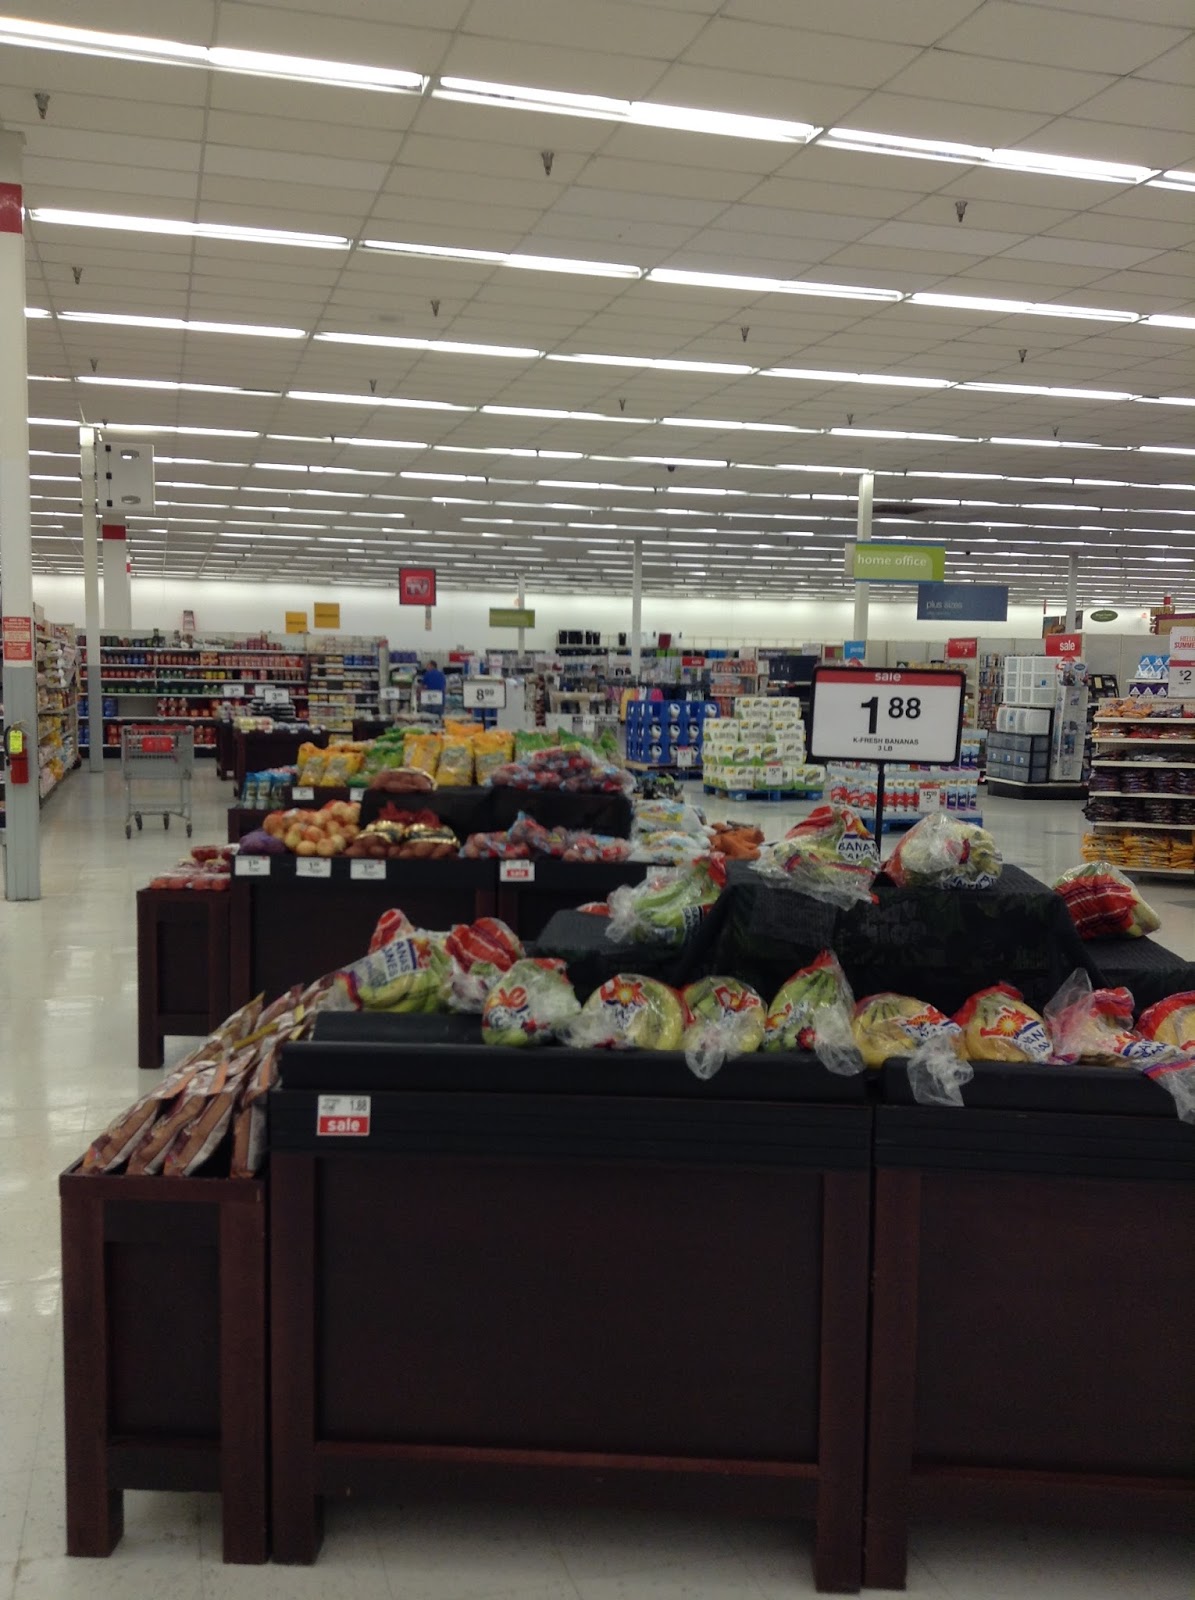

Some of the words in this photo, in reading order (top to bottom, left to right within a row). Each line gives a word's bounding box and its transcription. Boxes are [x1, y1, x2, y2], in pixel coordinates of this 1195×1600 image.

[857, 554, 891, 566] home
[895, 555, 927, 567] office
[926, 600, 942, 611] plus
[943, 601, 963, 610] sizes
[1059, 640, 1076, 651] sale
[874, 672, 902, 682] sale
[327, 1117, 360, 1132] sale
